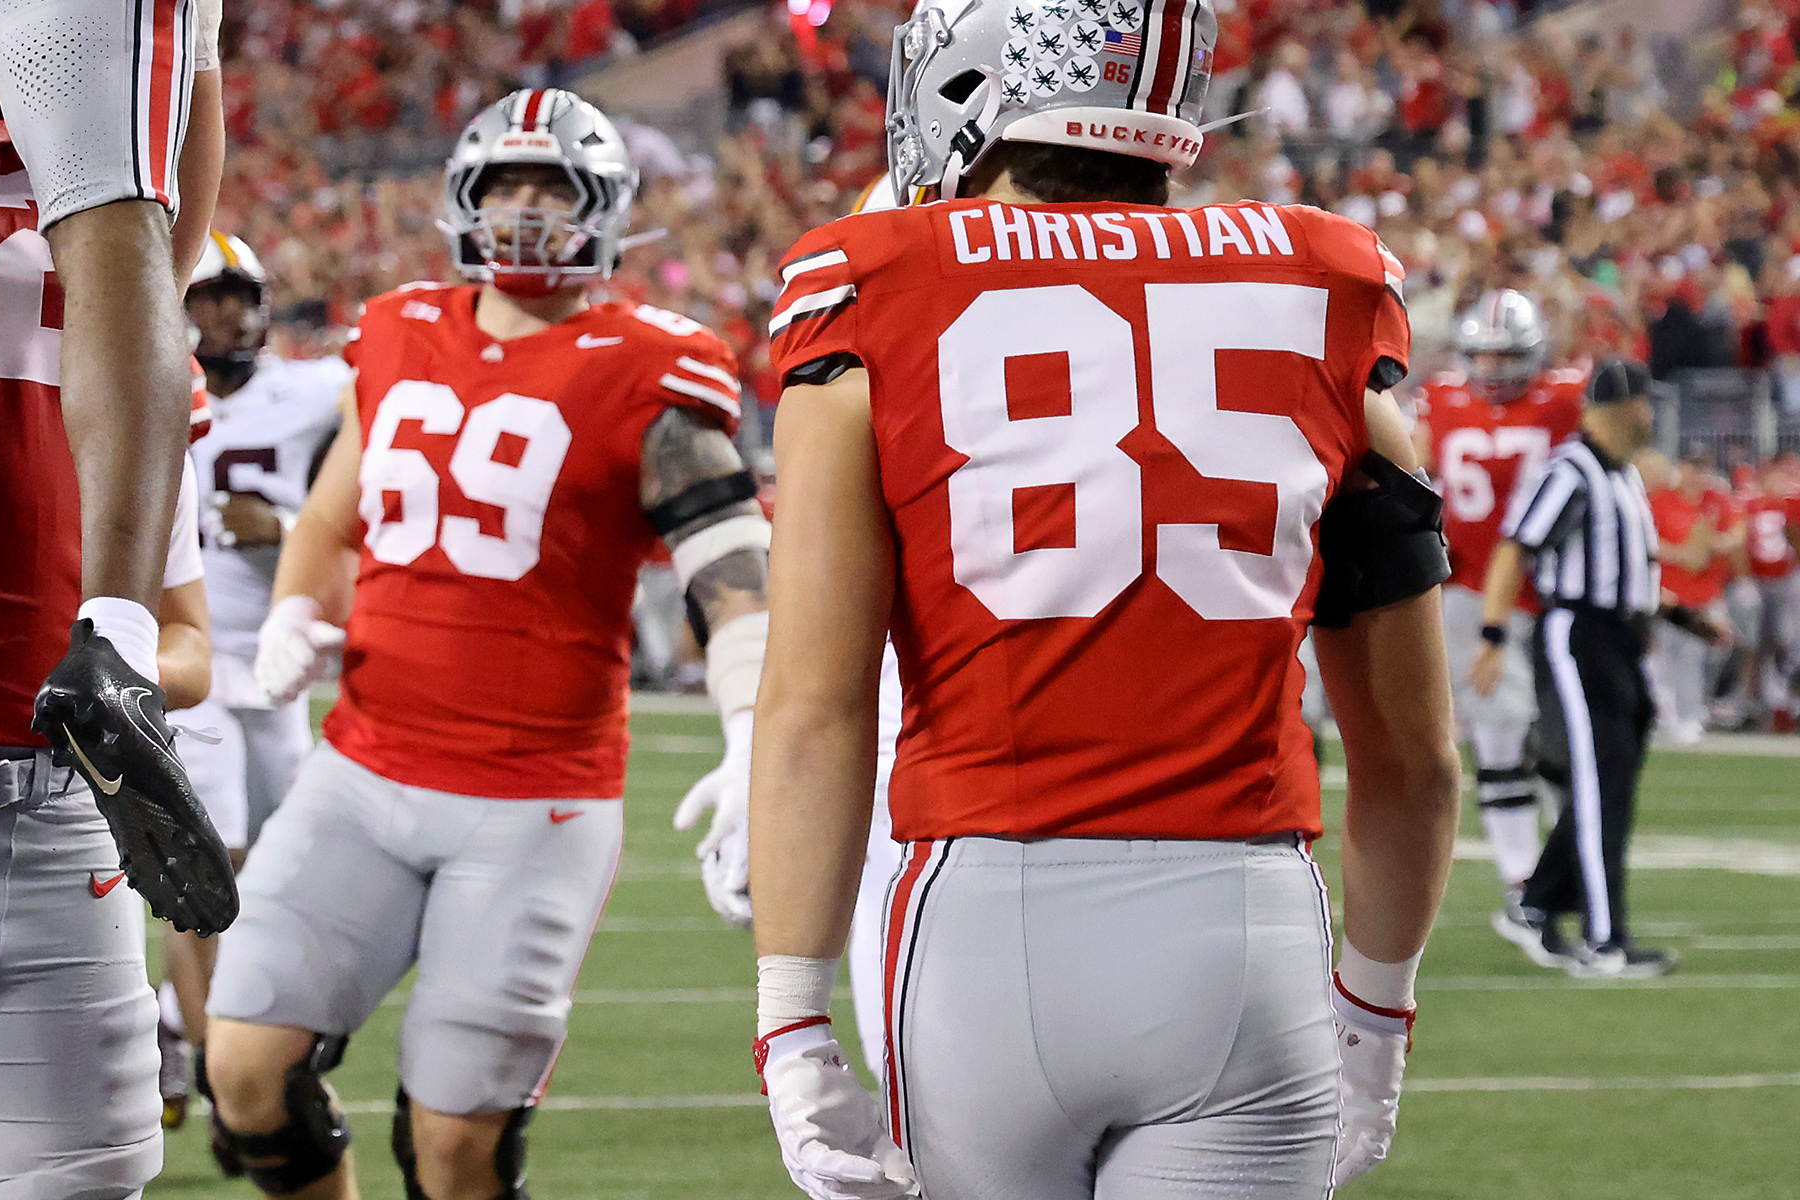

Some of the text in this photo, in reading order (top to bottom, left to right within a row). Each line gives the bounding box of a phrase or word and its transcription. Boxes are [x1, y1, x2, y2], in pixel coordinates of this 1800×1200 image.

[1103, 61, 1131, 84] 85
[948, 204, 1295, 264] CHRISTIAN
[358, 380, 573, 581] 69
[938, 283, 1330, 621] 85
[1440, 426, 1552, 538] 67
